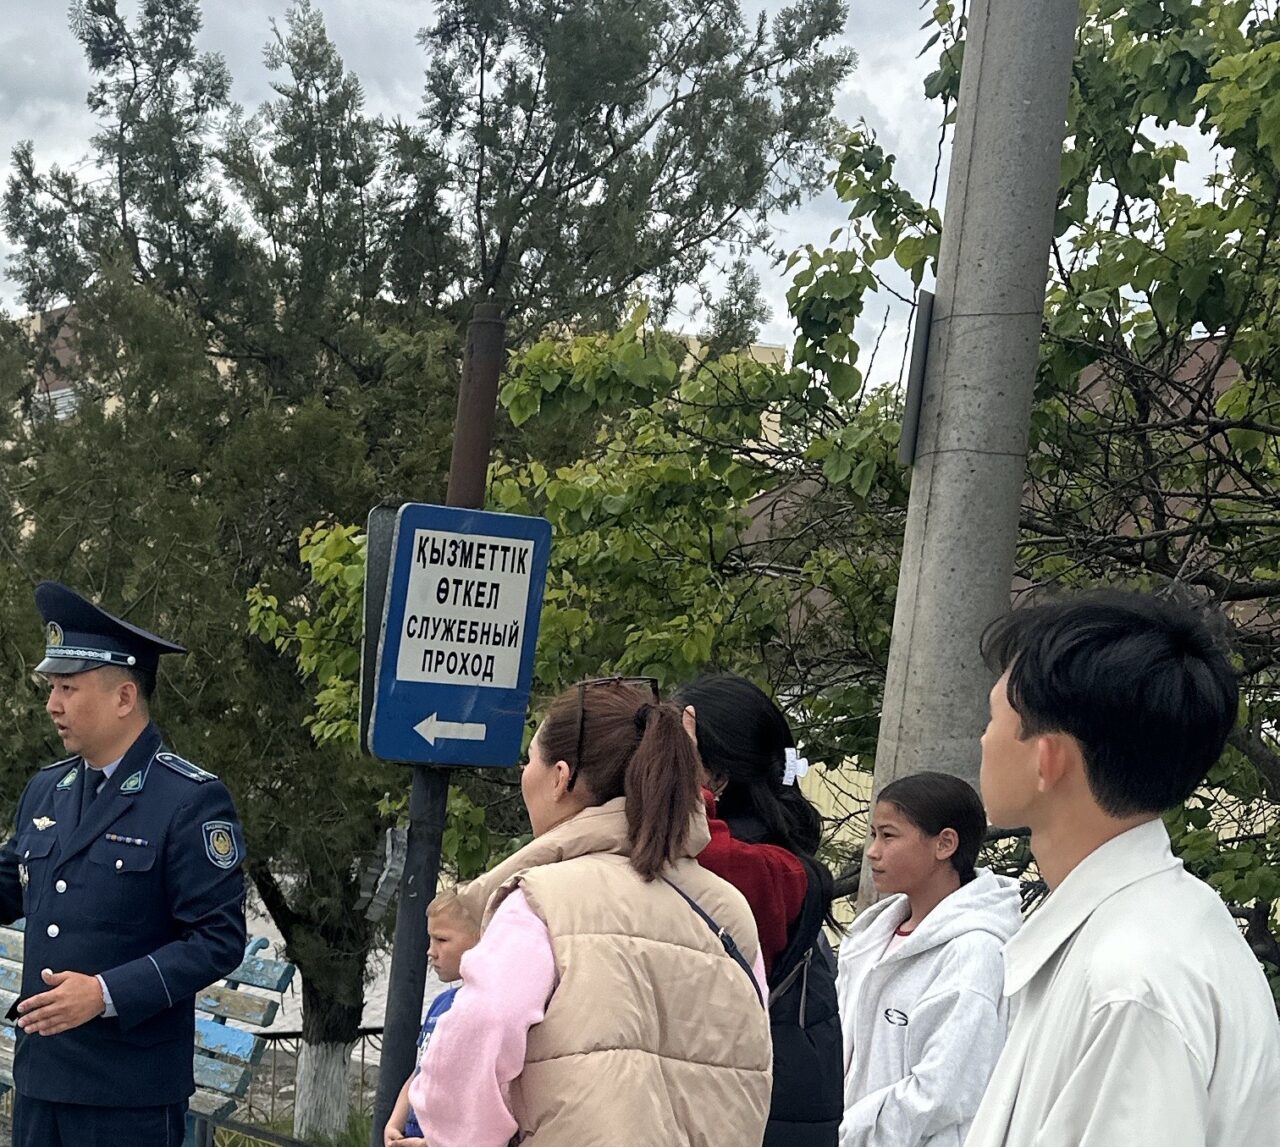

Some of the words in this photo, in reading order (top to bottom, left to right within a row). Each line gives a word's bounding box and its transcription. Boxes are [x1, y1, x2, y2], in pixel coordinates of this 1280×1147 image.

[416, 536, 529, 574] ҚЫЗМЕТТІК
[436, 577, 500, 609] ӨТКЕЛ
[406, 614, 519, 648] СЛУЖЕБНЫЙ
[421, 649, 495, 682] ПРОХОД
